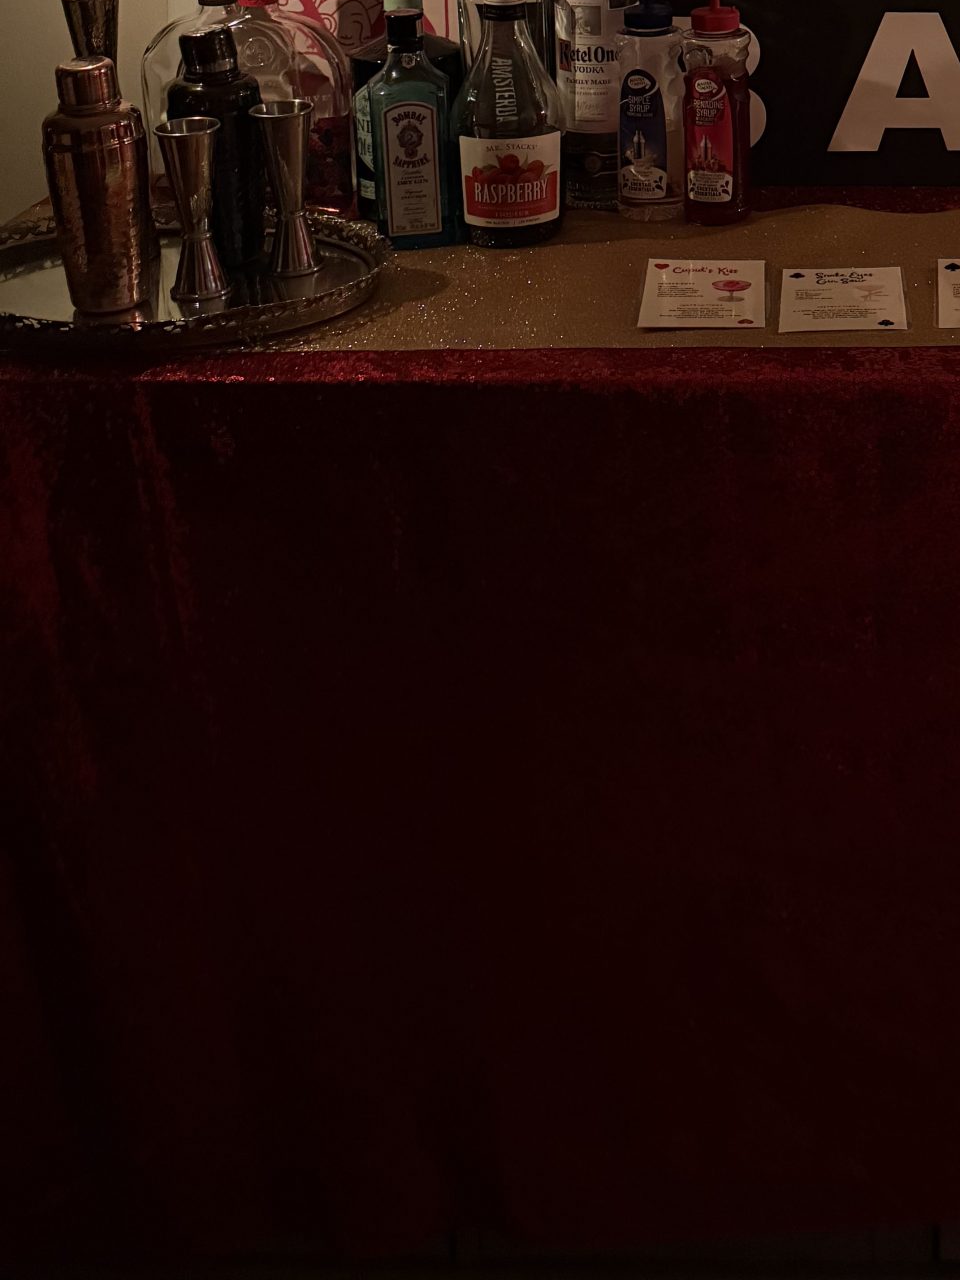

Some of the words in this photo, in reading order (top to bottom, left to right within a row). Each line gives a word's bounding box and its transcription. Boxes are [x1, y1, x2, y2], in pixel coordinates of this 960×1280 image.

[559, 40, 592, 69] Ketel
[573, 65, 605, 74] VODKA
[491, 57, 520, 124] AMSTERDA
[628, 95, 652, 104] SIMPLE
[628, 104, 650, 113] SYRUP
[696, 108, 717, 117] SYRUP
[392, 111, 427, 127] BOMBAY
[393, 153, 431, 168] SAPPHIRE
[474, 180, 548, 204] RASPBERRY
